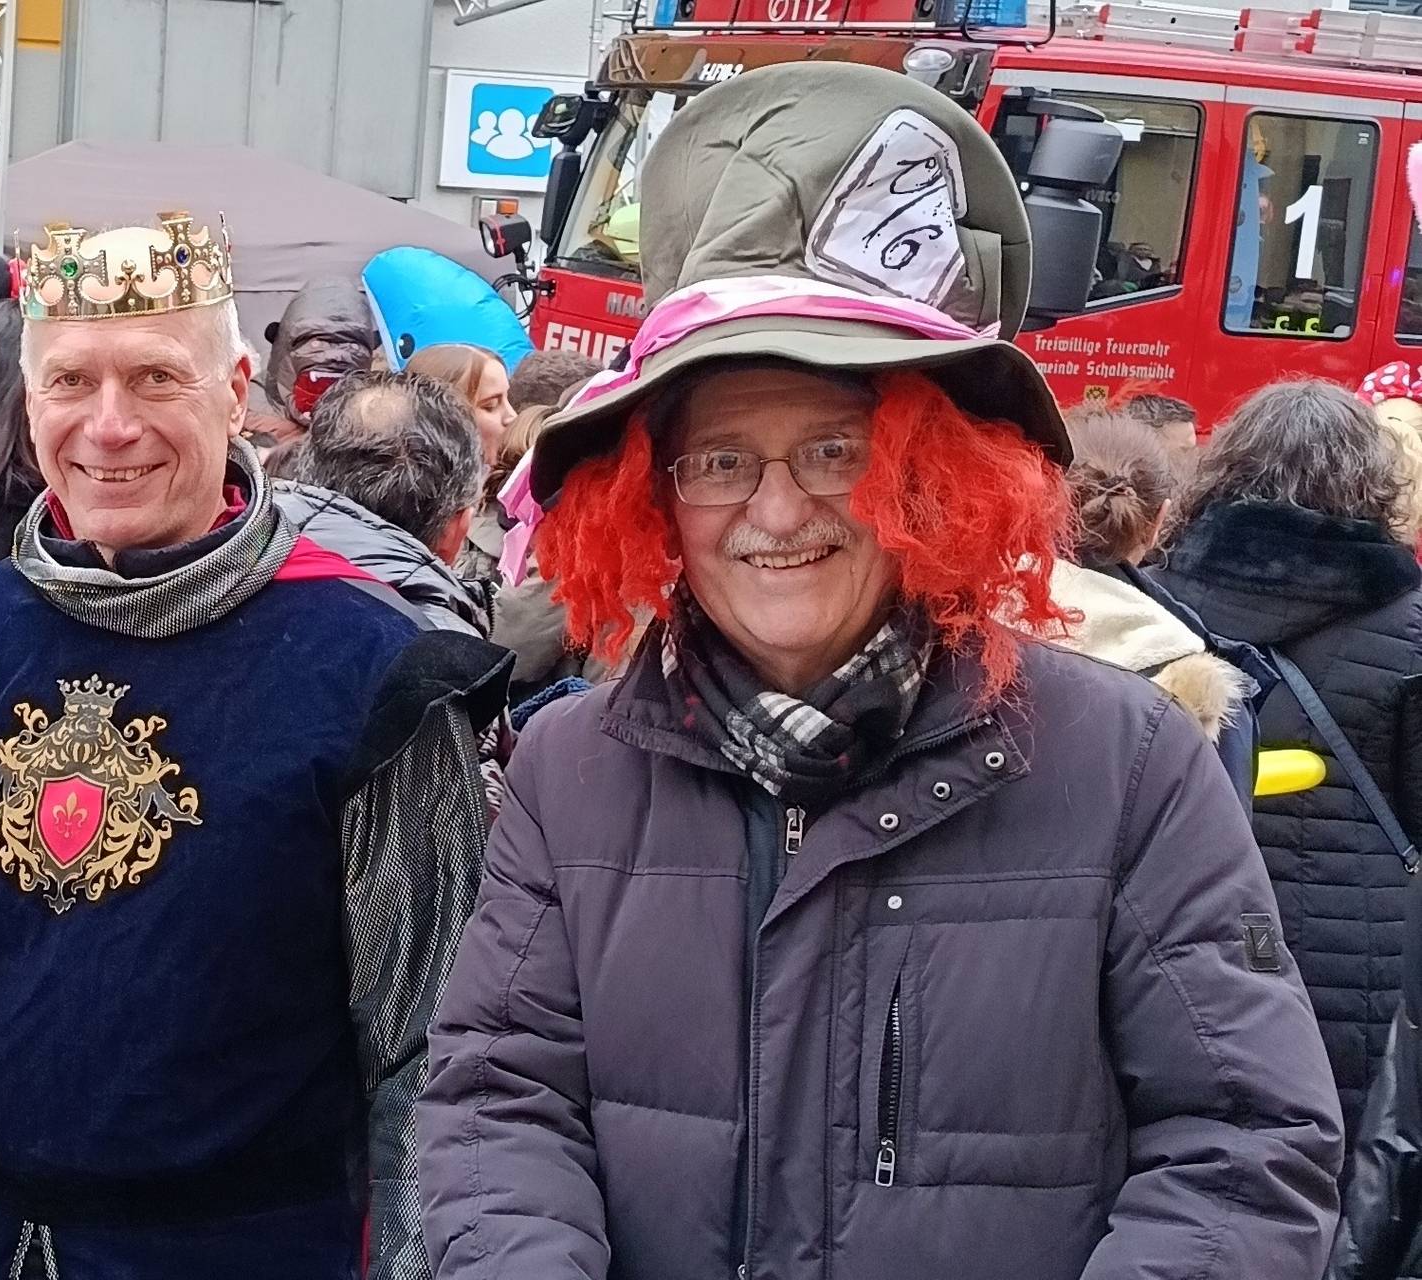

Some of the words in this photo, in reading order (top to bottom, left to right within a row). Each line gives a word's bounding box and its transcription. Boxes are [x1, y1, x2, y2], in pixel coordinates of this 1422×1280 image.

[1285, 185, 1323, 279] 1
[543, 322, 633, 370] FEUE
[1035, 334, 1101, 356] Freiwillige
[1106, 337, 1171, 358] Feuerwehr
[1036, 359, 1079, 375] meinde
[1086, 360, 1176, 379] Schalksmühle
